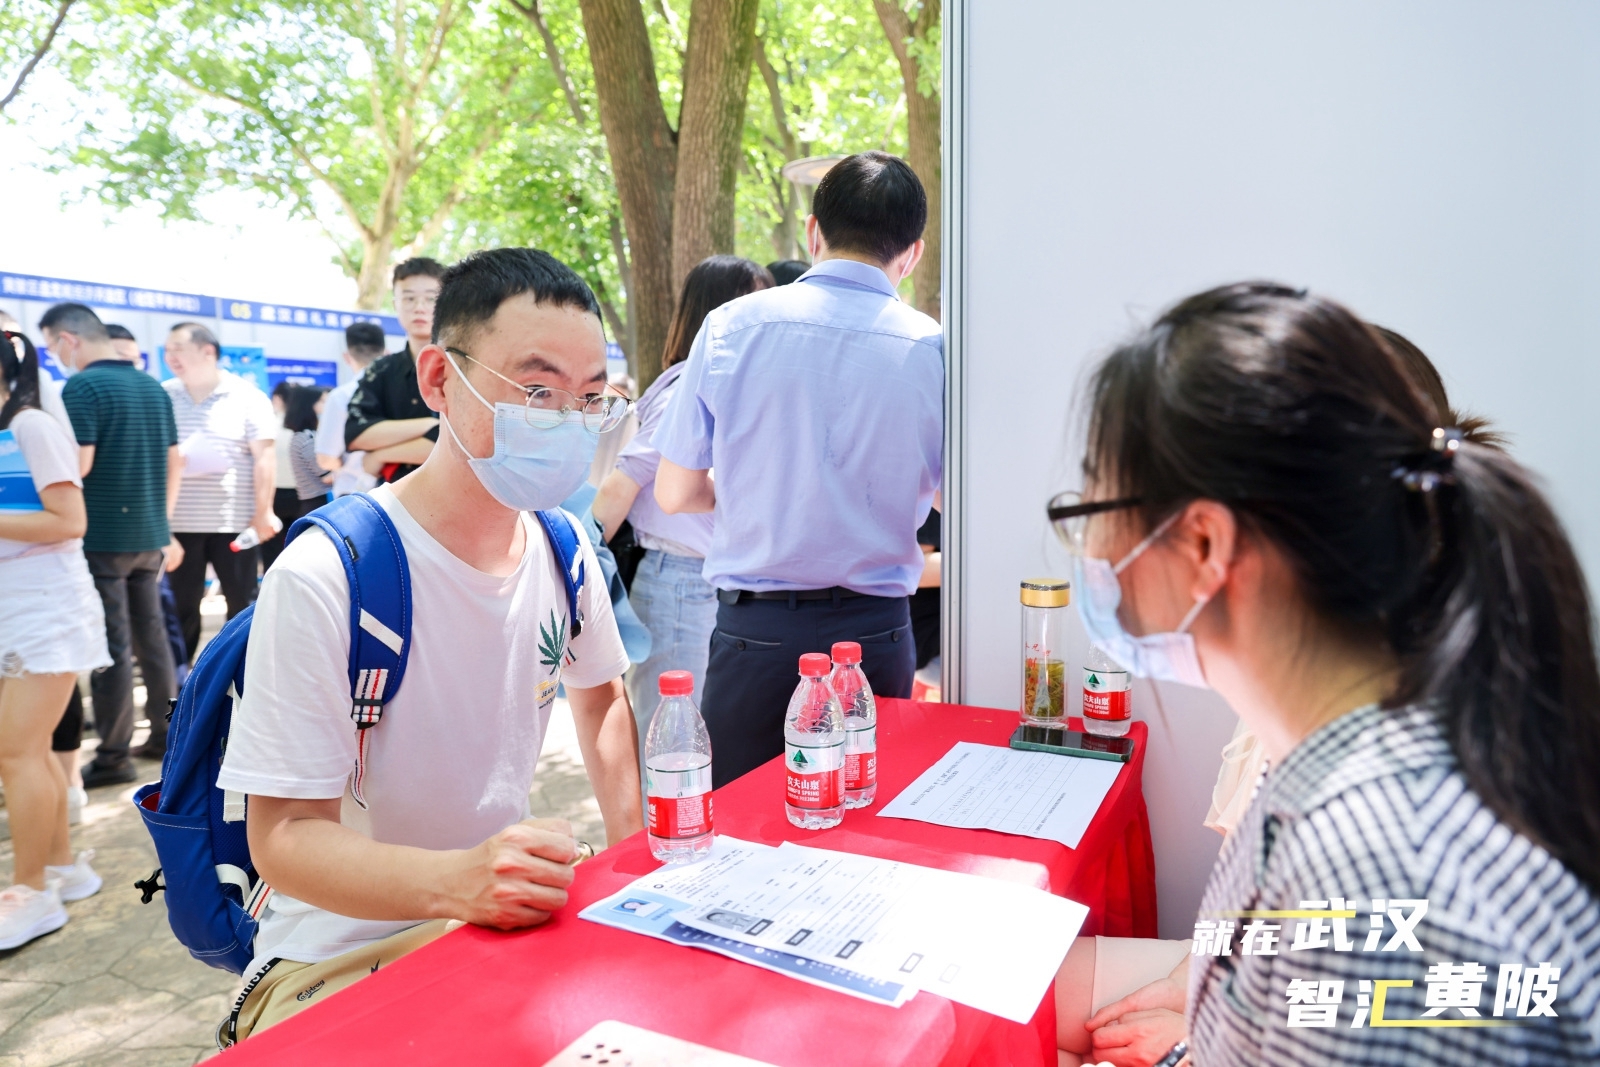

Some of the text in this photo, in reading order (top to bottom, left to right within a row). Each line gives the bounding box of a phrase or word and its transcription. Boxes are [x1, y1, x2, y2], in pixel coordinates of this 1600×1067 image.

[787, 775, 820, 791] 农夫山泉
[232, 963, 272, 1013] FASHION
